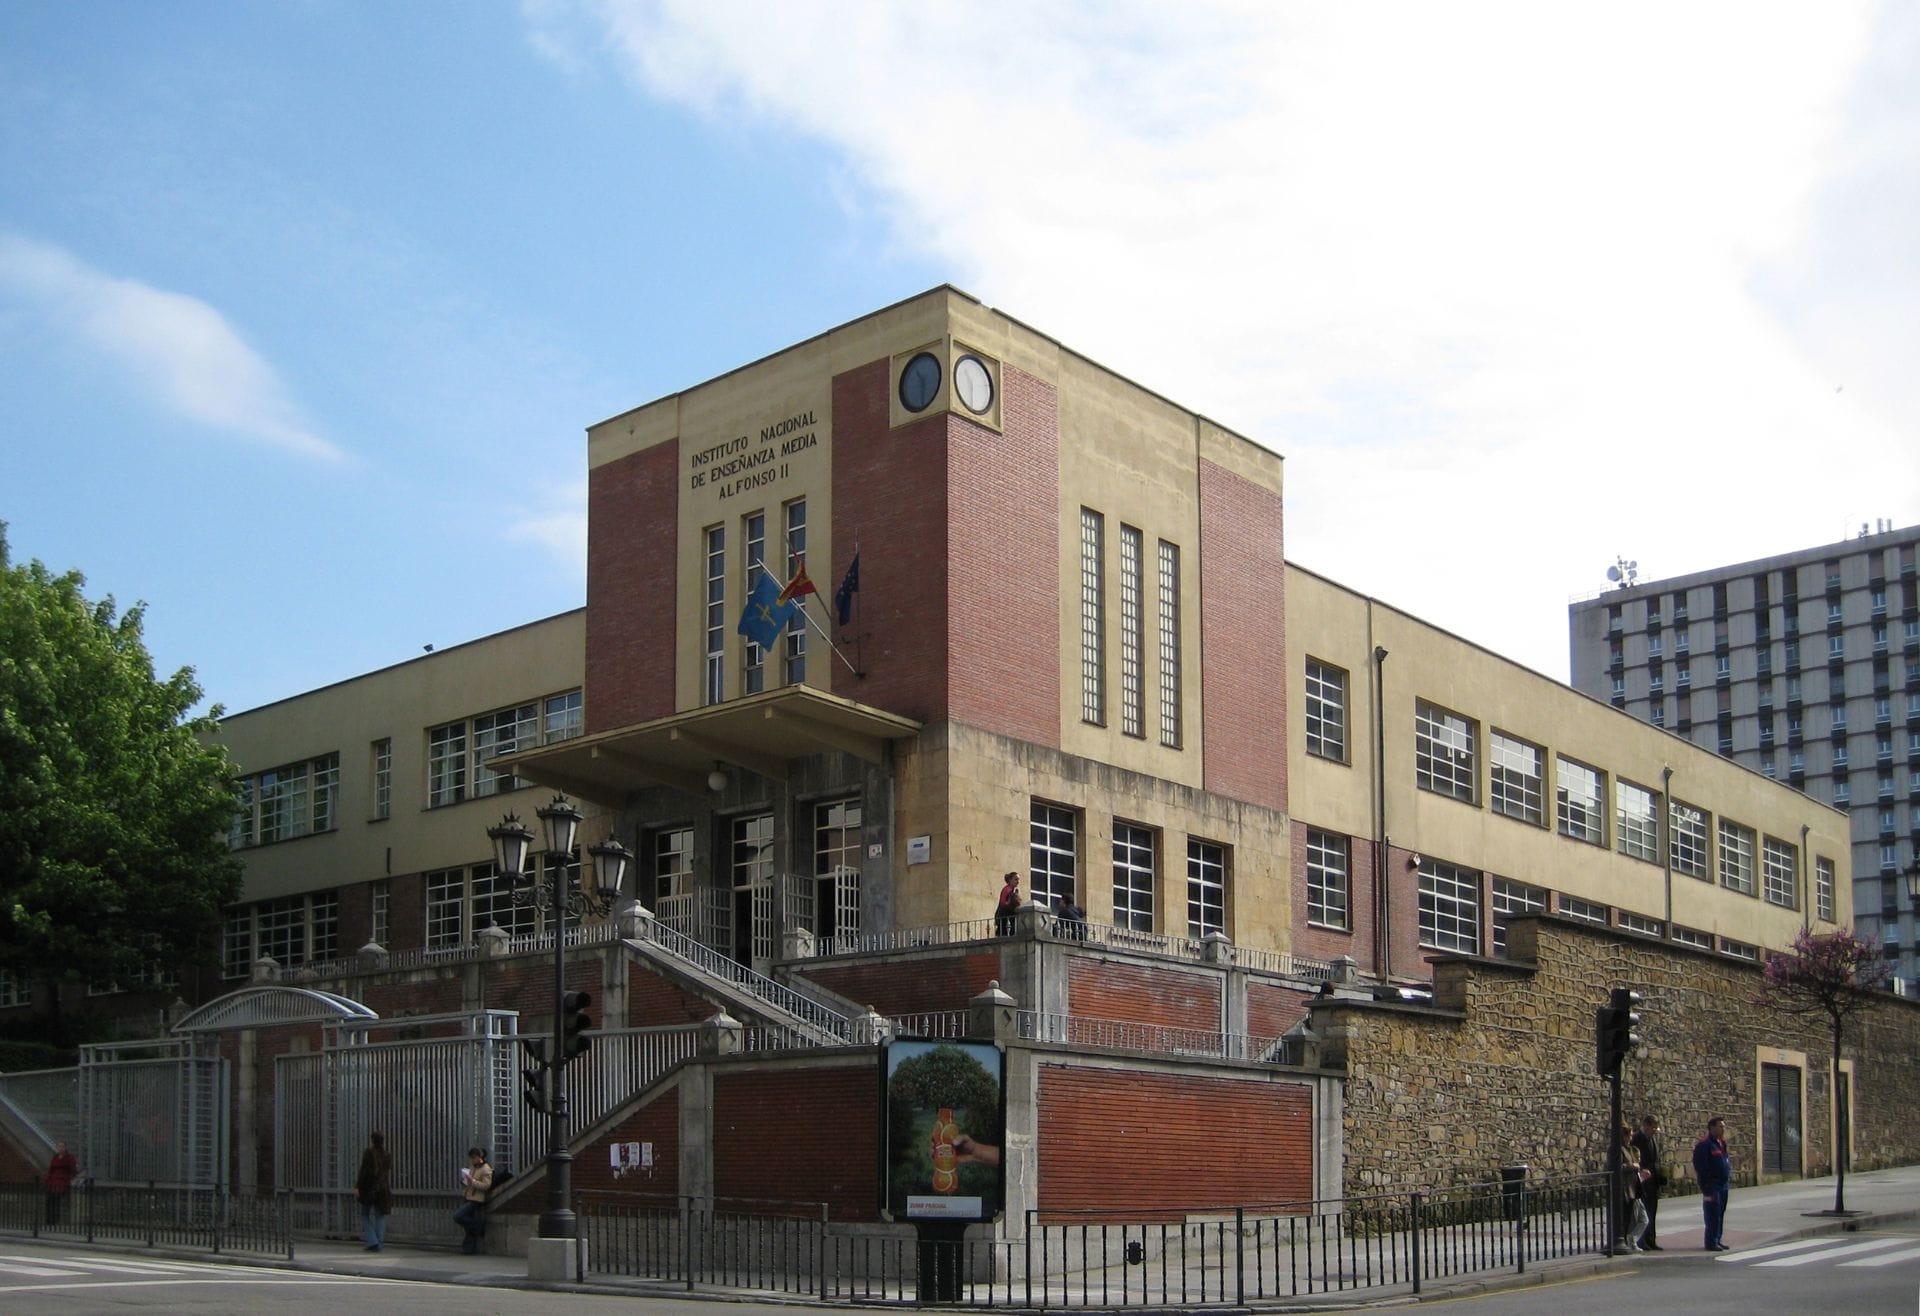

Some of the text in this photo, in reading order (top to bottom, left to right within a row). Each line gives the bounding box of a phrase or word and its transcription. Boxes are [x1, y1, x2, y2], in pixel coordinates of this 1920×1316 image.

[691, 410, 818, 468] INSTITUTO NACIONAL
[691, 432, 818, 490] DE ENSEÑANZA MEDIA
[718, 463, 789, 500] ALFONSO II
